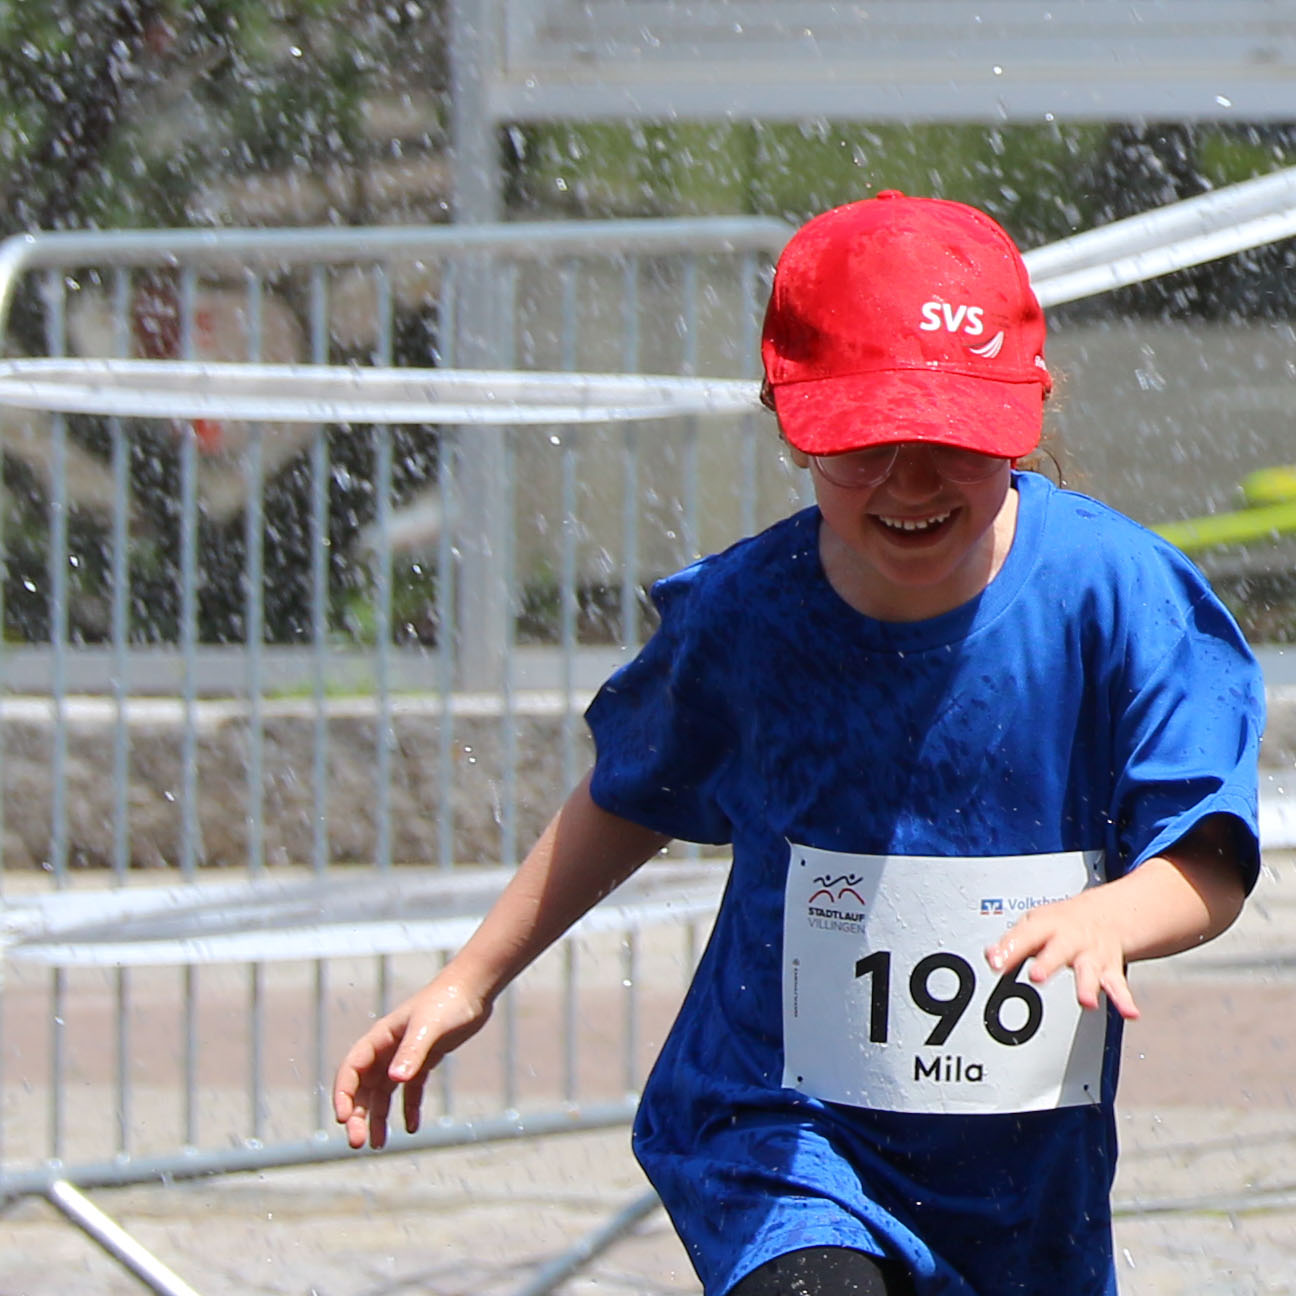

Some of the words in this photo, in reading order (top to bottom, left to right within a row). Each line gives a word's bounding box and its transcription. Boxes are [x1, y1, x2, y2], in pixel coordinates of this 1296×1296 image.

[919, 301, 984, 336] SVS
[808, 907, 865, 922] STADTLAUF
[808, 917, 866, 934] VILLINGEN
[855, 950, 1044, 1047] 196
[913, 1057, 984, 1082] Mila
